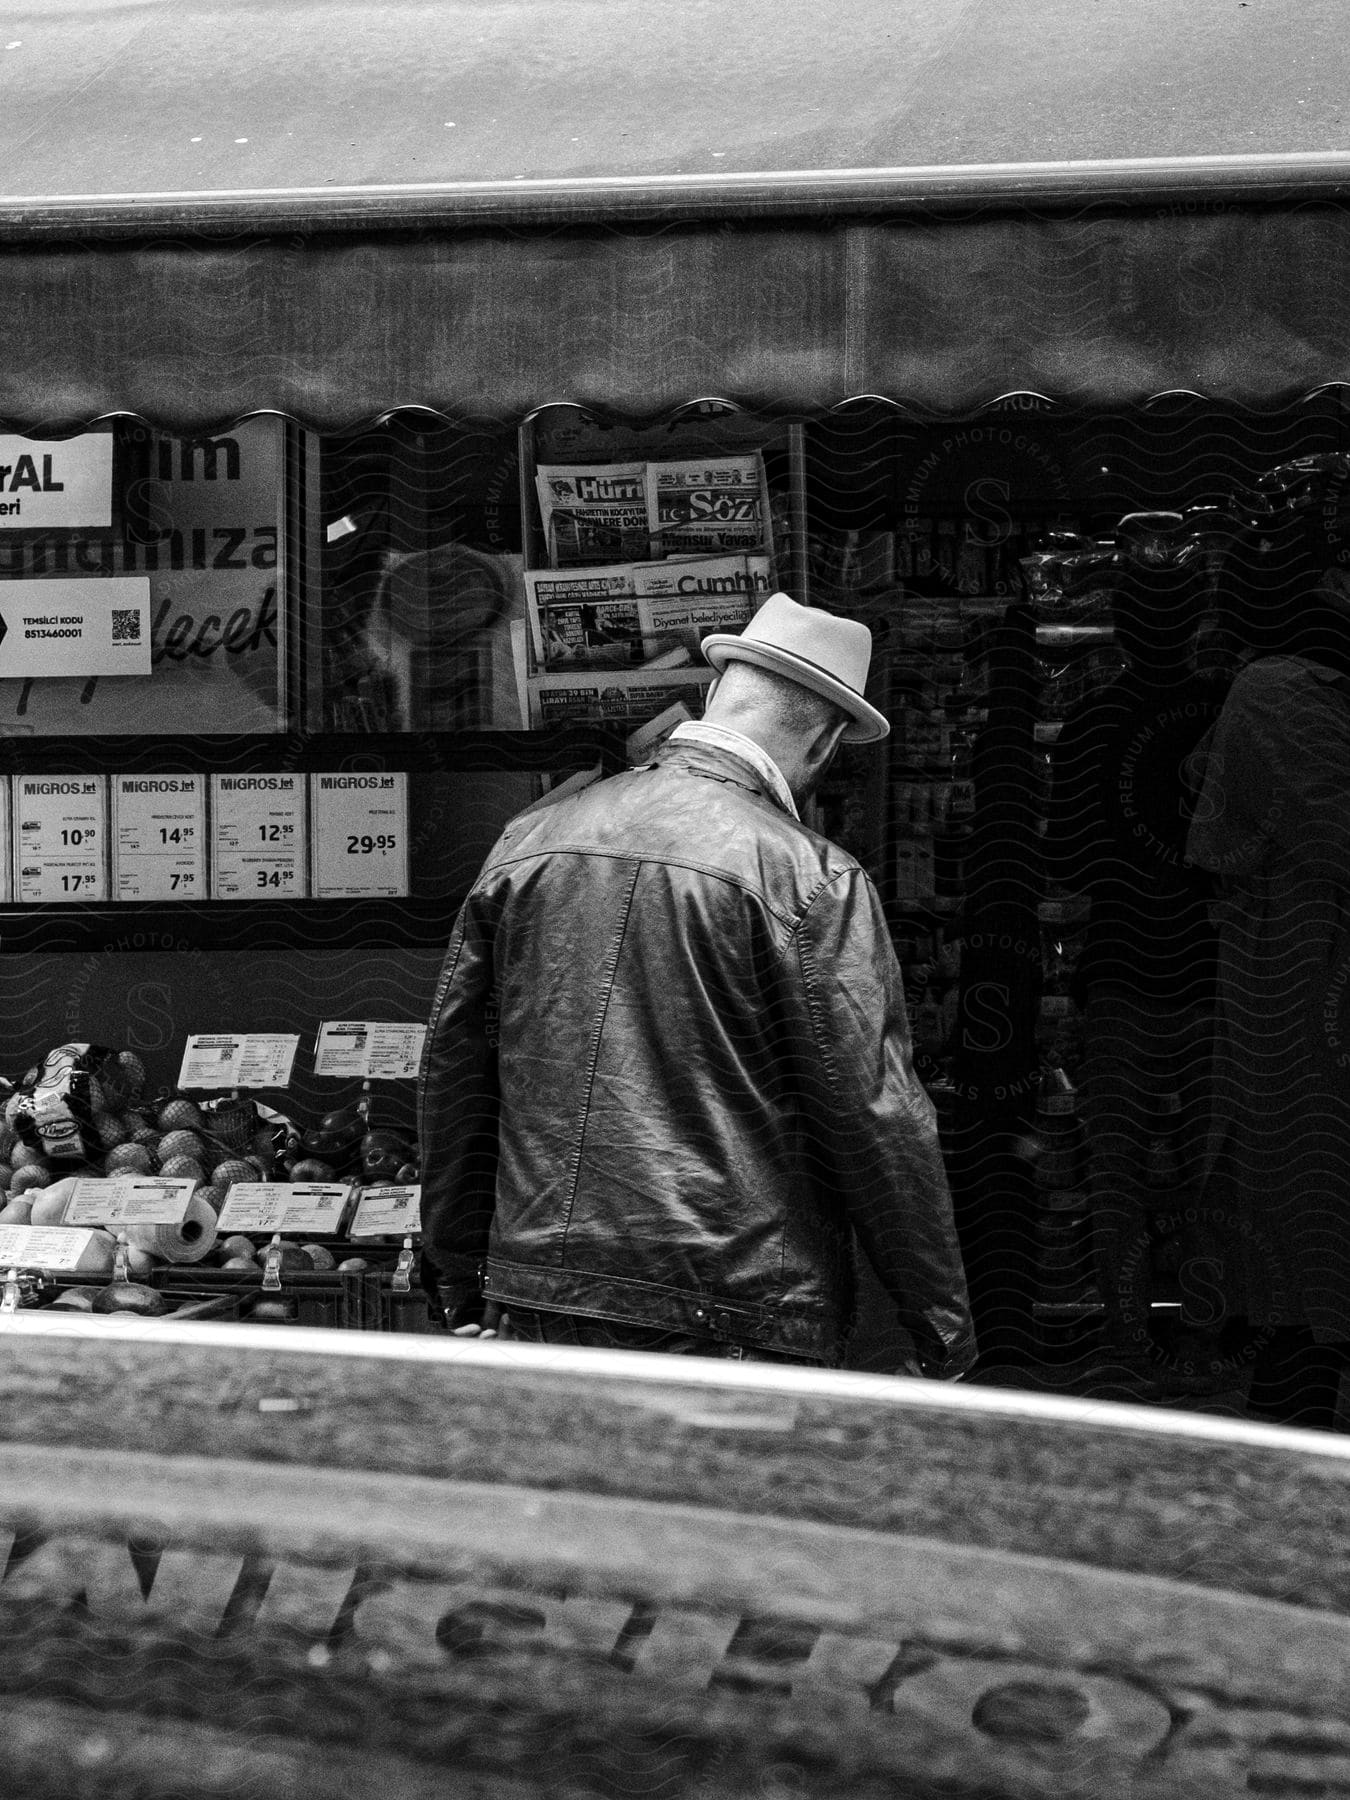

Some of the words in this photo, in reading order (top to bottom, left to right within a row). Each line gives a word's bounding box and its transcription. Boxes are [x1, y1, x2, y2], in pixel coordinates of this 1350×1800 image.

[60, 616, 84, 625] KODU
[653, 614, 689, 628] Diyanet
[25, 629, 82, 639] 8513460001
